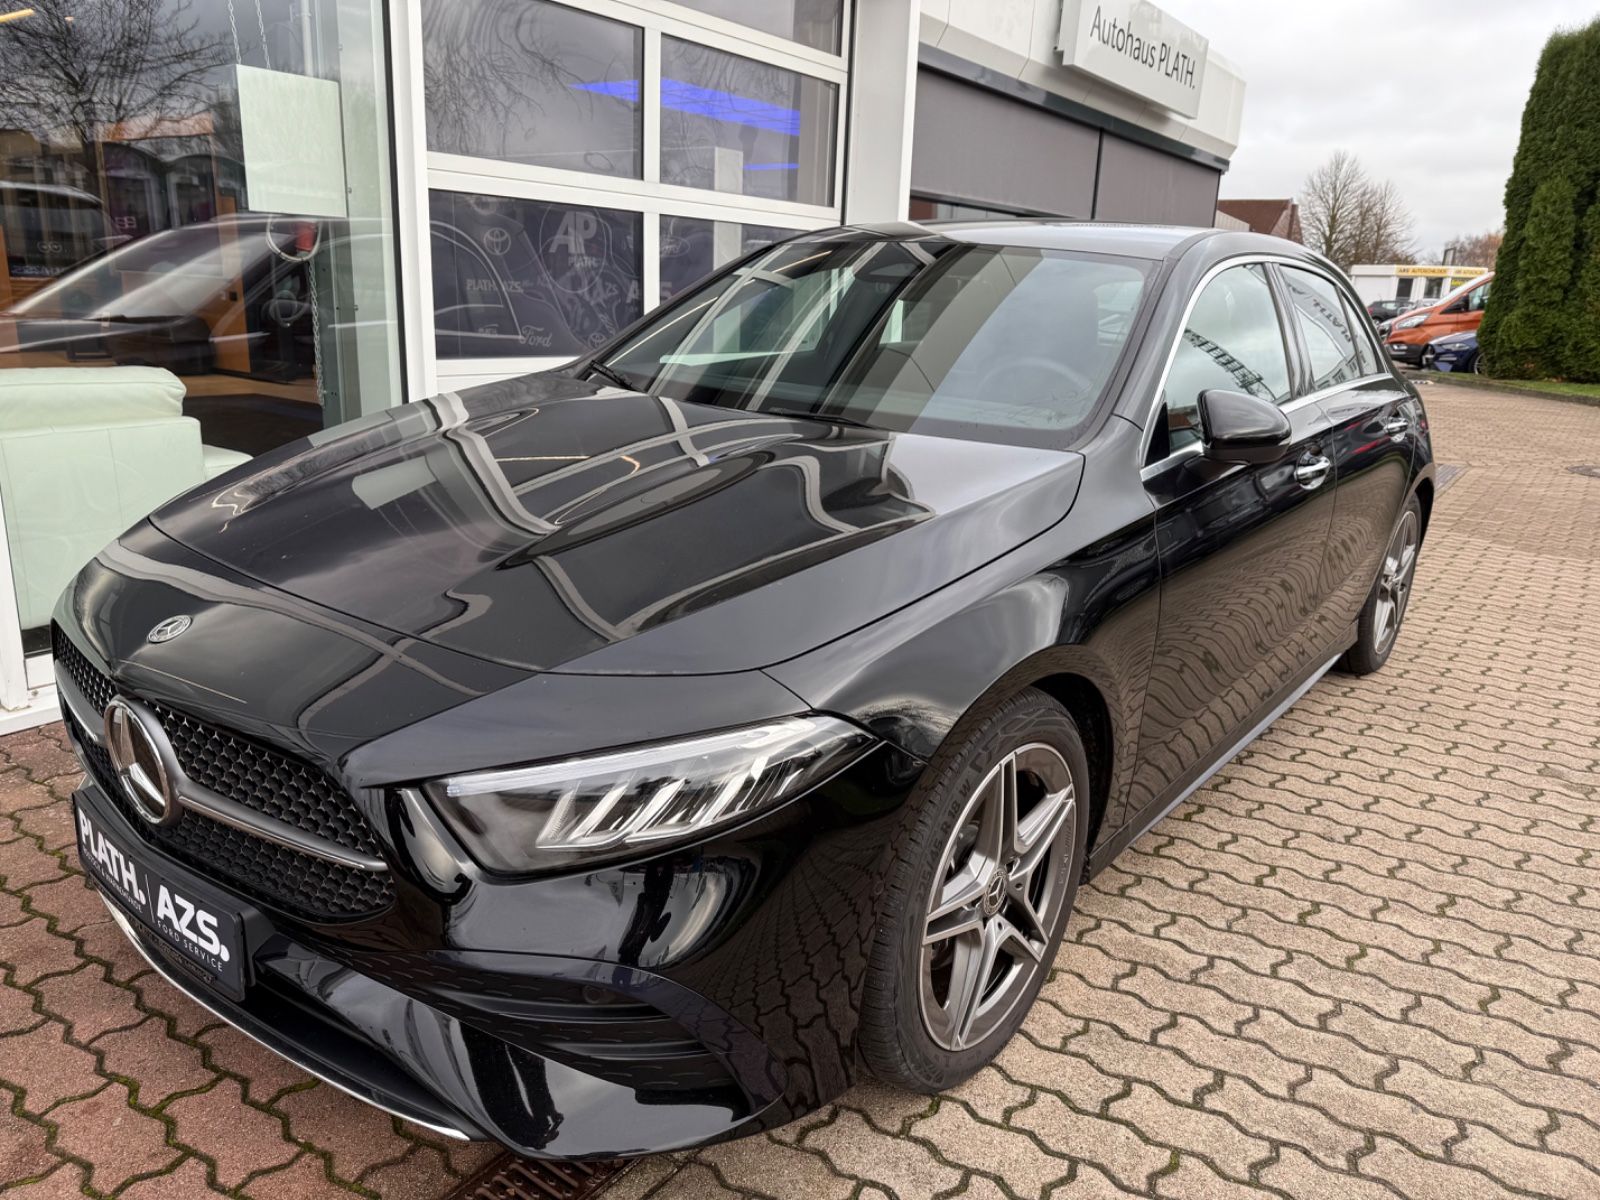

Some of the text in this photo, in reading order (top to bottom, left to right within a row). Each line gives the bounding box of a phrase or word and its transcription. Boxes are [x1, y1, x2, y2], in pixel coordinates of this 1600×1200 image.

[1090, 5, 1196, 90] Autohaus PLATH.
[519, 324, 553, 348] Ford
[78, 807, 147, 905] PLATH.
[157, 884, 230, 962] AZS.
[157, 920, 224, 973] FORD SERVICE
